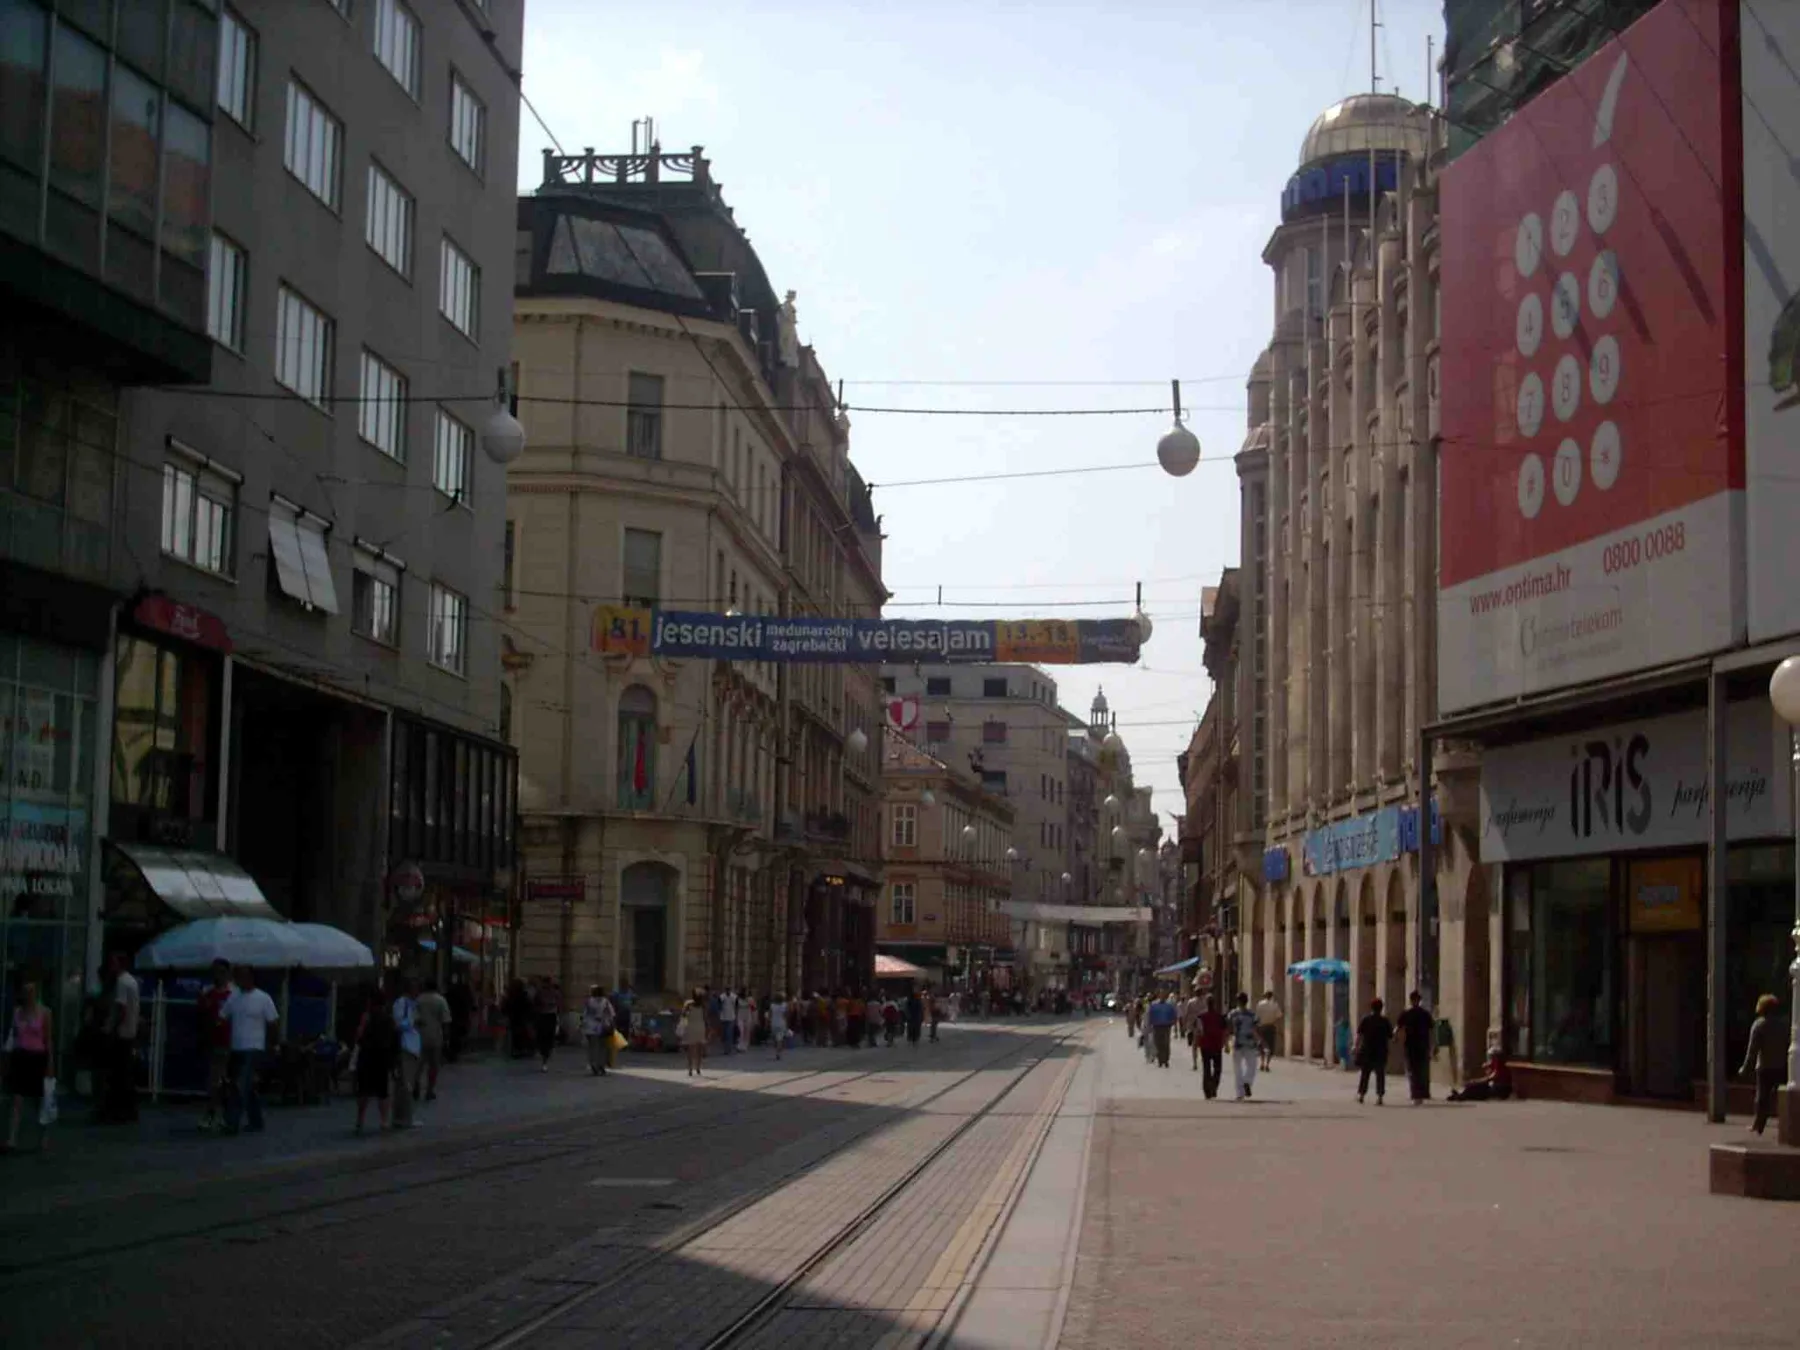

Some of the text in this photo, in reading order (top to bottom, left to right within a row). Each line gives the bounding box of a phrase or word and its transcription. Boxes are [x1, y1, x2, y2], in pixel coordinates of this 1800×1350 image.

[1602, 521, 1686, 577] 0800 0088
[1469, 562, 1572, 616] www.optima.hr
[653, 615, 763, 649] jesenski
[857, 626, 991, 655] velesajam
